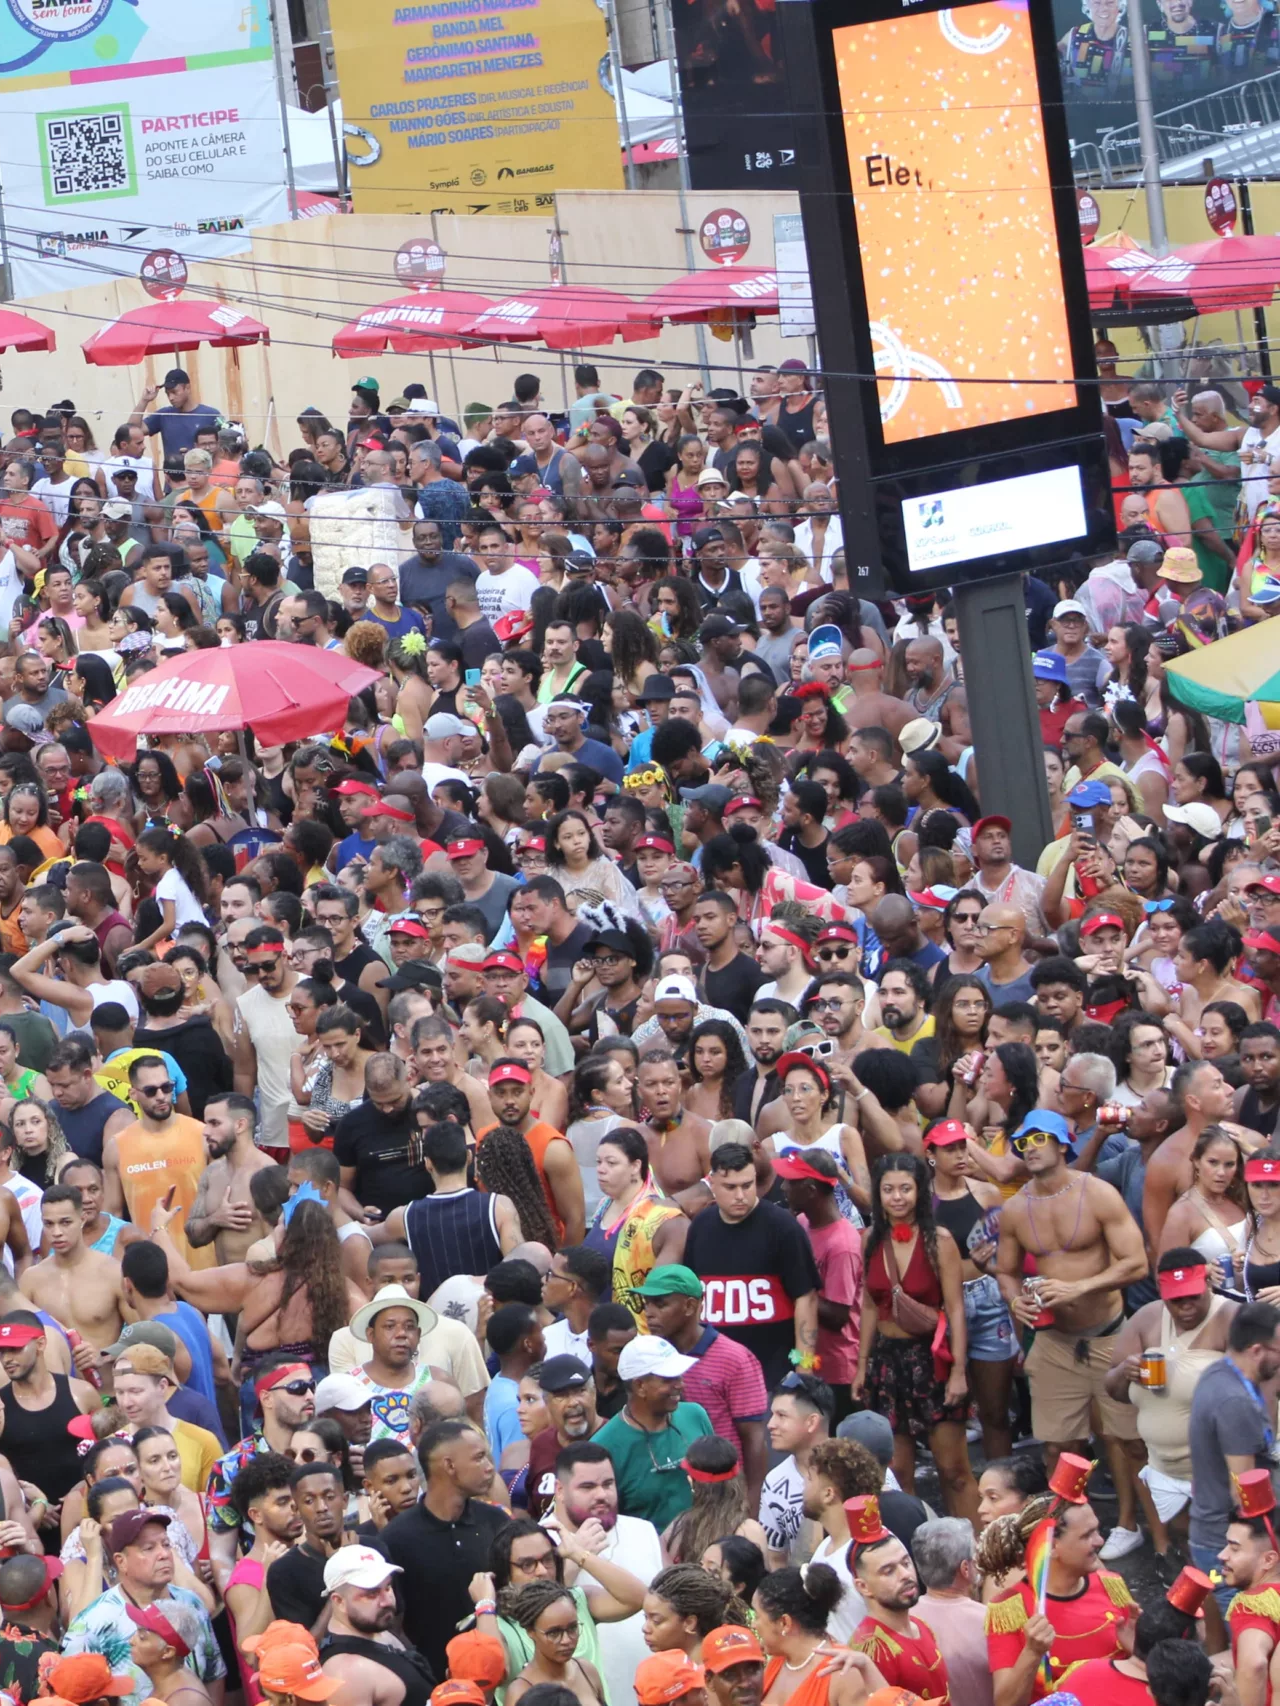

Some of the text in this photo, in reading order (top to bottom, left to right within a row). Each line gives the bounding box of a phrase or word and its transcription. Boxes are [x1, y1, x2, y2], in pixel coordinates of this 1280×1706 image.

[32, 4, 93, 20] sem fome
[394, 1, 480, 23] ARMANDINHO
[432, 16, 505, 38] BANDA MEL
[407, 33, 536, 62] GERÔNIMO SANTANA
[404, 52, 543, 83] MARGARETH MENEZES
[370, 100, 415, 117] CARLOS
[417, 92, 477, 112] PRAZERES
[497, 87, 535, 102] MUSICAL
[537, 87, 542, 96] E
[141, 108, 240, 135] PARTICIPE
[389, 117, 434, 133] MANNO
[531, 106, 537, 115] E
[538, 99, 575, 114] SOLISTA)
[145, 132, 246, 153] APONTE A CÂMERA
[408, 131, 446, 149] MÁRIO
[449, 126, 494, 142] SOARES
[146, 145, 247, 167] DO SEU CELULAR E
[148, 163, 214, 181] SAIBA COMO
[198, 218, 244, 235] BAHIA
[354, 304, 445, 333] BRAHMA
[857, 566, 869, 577] 267
[112, 677, 230, 717] BRAHMA
[127, 1159, 167, 1174] OSKLEN
